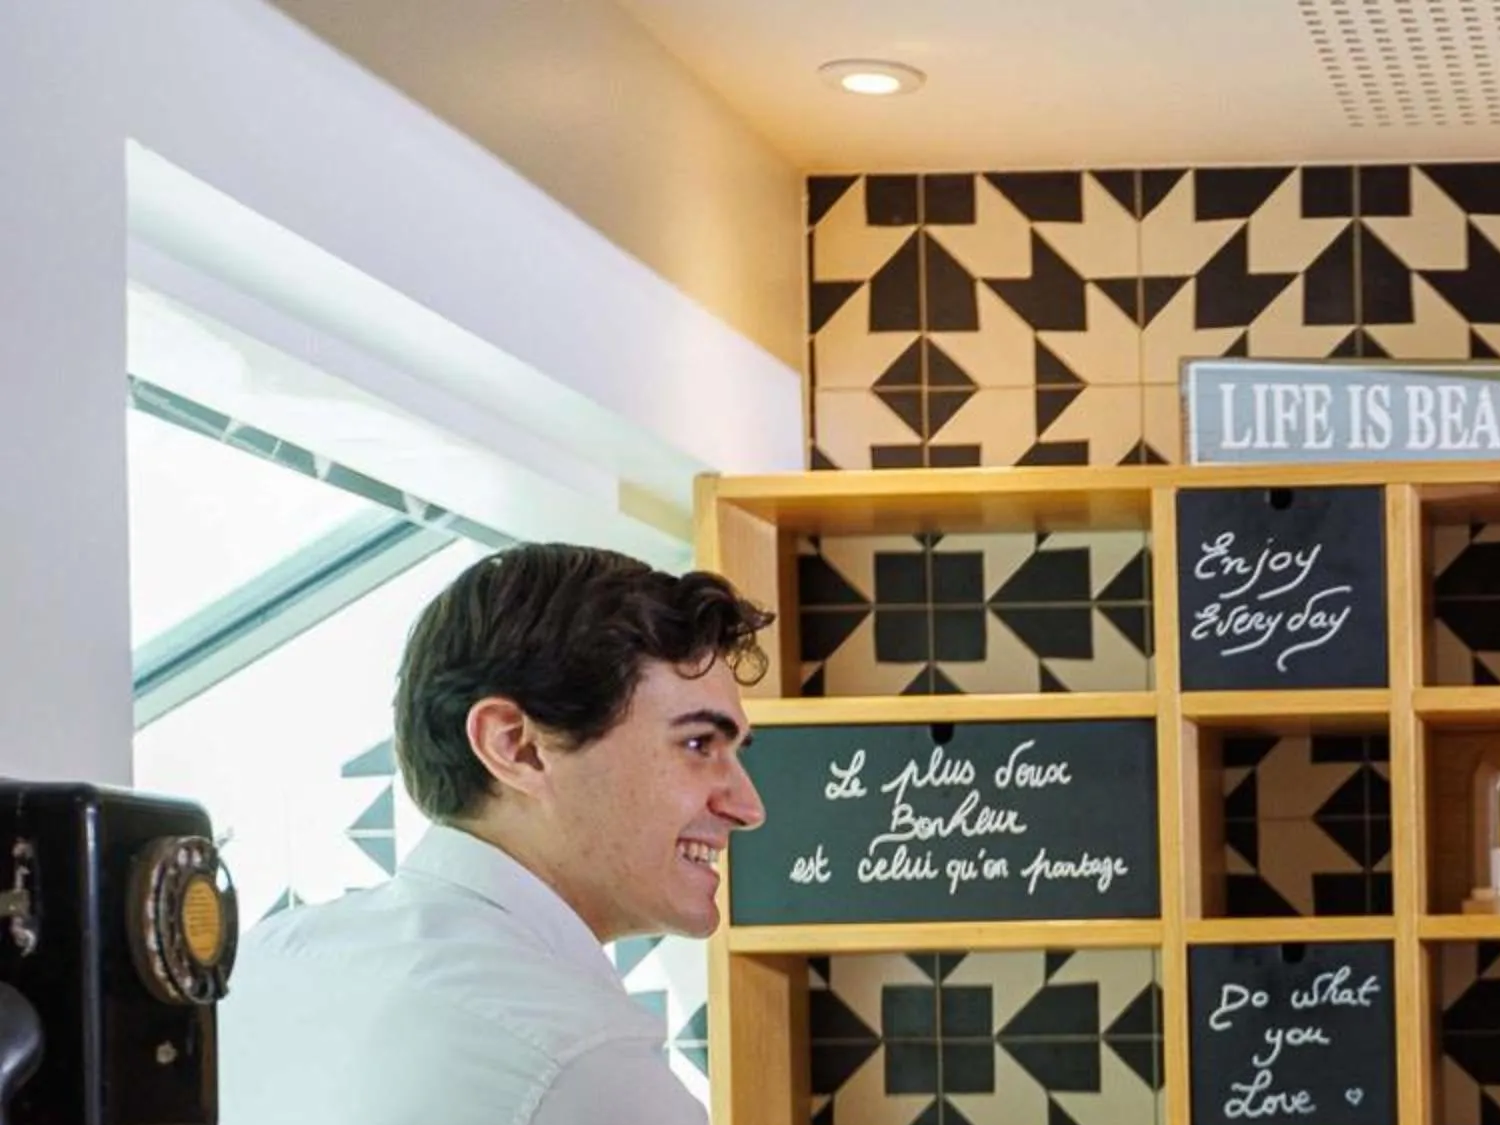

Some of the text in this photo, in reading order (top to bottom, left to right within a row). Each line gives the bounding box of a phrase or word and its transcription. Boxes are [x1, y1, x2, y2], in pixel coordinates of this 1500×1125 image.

[1218, 382, 1334, 450] LIFE
[1346, 383, 1393, 450] IS
[1194, 531, 1322, 600] Enjoy
[825, 740, 1072, 803] Le plus doux
[869, 790, 1028, 856] Bonheur
[790, 843, 1129, 895] est celui qu'on partage
[1209, 965, 1382, 1031] Do what
[1252, 1026, 1331, 1068] you
[1224, 1069, 1317, 1118] Love
